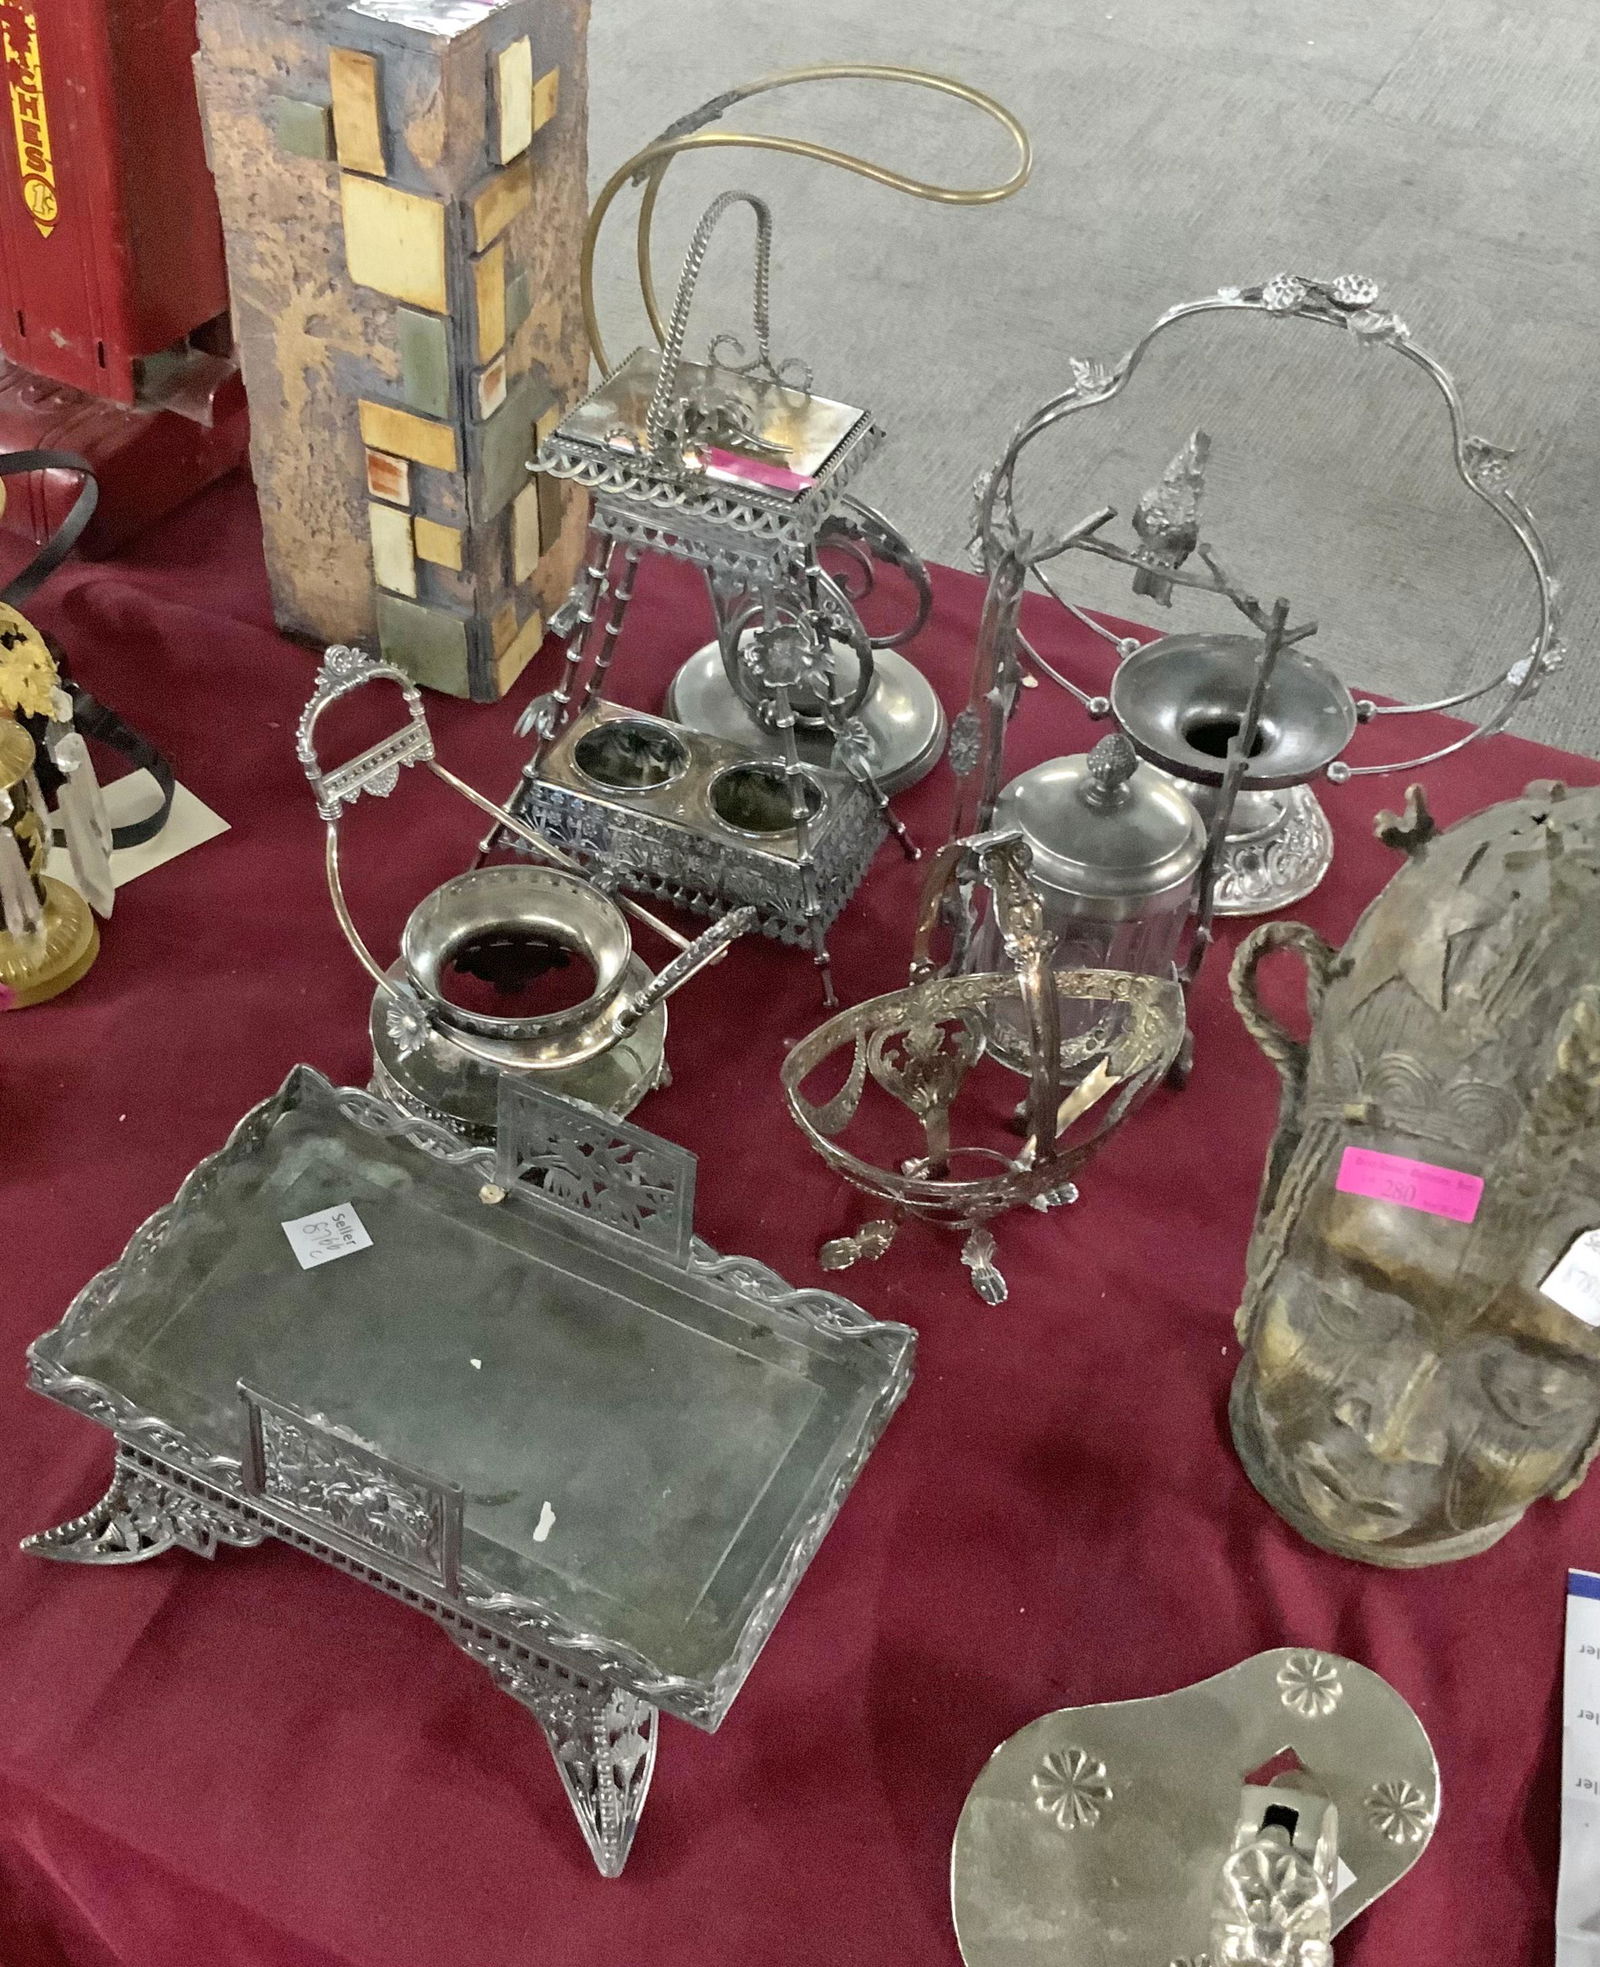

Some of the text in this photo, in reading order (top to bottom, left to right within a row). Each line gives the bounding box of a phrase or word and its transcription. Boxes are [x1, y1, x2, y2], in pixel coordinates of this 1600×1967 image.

[1382, 1179, 1417, 1203] 280
[331, 1213, 357, 1246] Seller
[1575, 1777, 1600, 1795] ler
